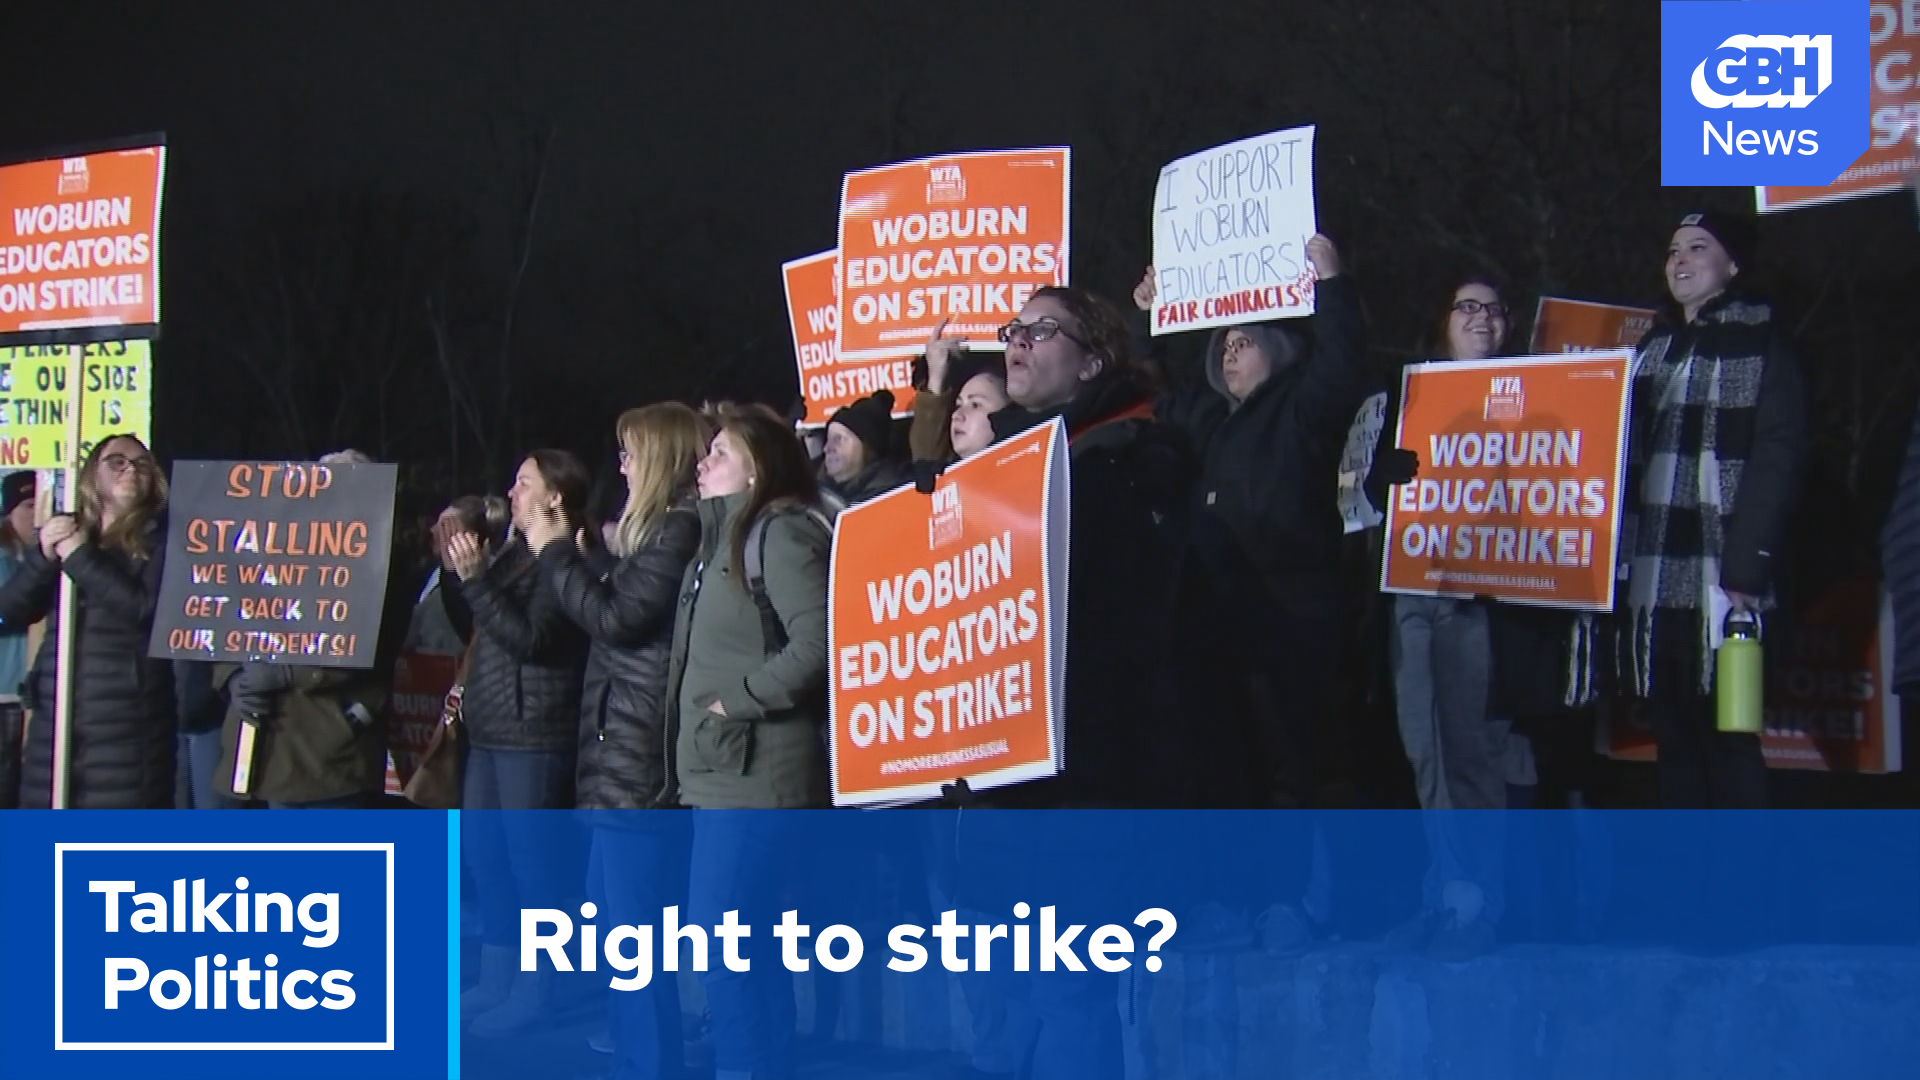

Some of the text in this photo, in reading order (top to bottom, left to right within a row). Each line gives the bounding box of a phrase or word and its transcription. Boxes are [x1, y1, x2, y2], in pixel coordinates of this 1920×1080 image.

[930, 165, 962, 181] WTA
[1160, 138, 1302, 213] I SUPPORT
[14, 196, 131, 236] WOBURN
[872, 205, 1028, 247] WOBURN
[1171, 196, 1270, 252] WOBURN
[0, 233, 150, 275] EDUCATORS
[848, 243, 1056, 289] EDUCATORS
[0, 274, 144, 313] ON STRIKE!
[852, 291, 900, 324] ON
[1158, 300, 1198, 328] FAIR
[37, 364, 137, 392] OUSIDE
[809, 361, 913, 401] ON STRIKE!
[1491, 376, 1521, 395] WTA
[102, 400, 121, 425] IS
[1430, 427, 1582, 467] WOBURN
[227, 464, 332, 498] STOP
[931, 482, 959, 514] WTA
[1399, 477, 1606, 518] EDUCATORS
[186, 518, 368, 557] STALLING
[1402, 522, 1594, 567] ON STRIKE!
[192, 564, 350, 587] WE WANT TO
[867, 530, 1012, 624] WOBURN
[185, 595, 349, 621] GET BACK TO
[169, 629, 356, 655] OUR STUDENTS!
[840, 588, 1039, 691] EDUCATORS
[848, 660, 1033, 749] ON STRIKE!
